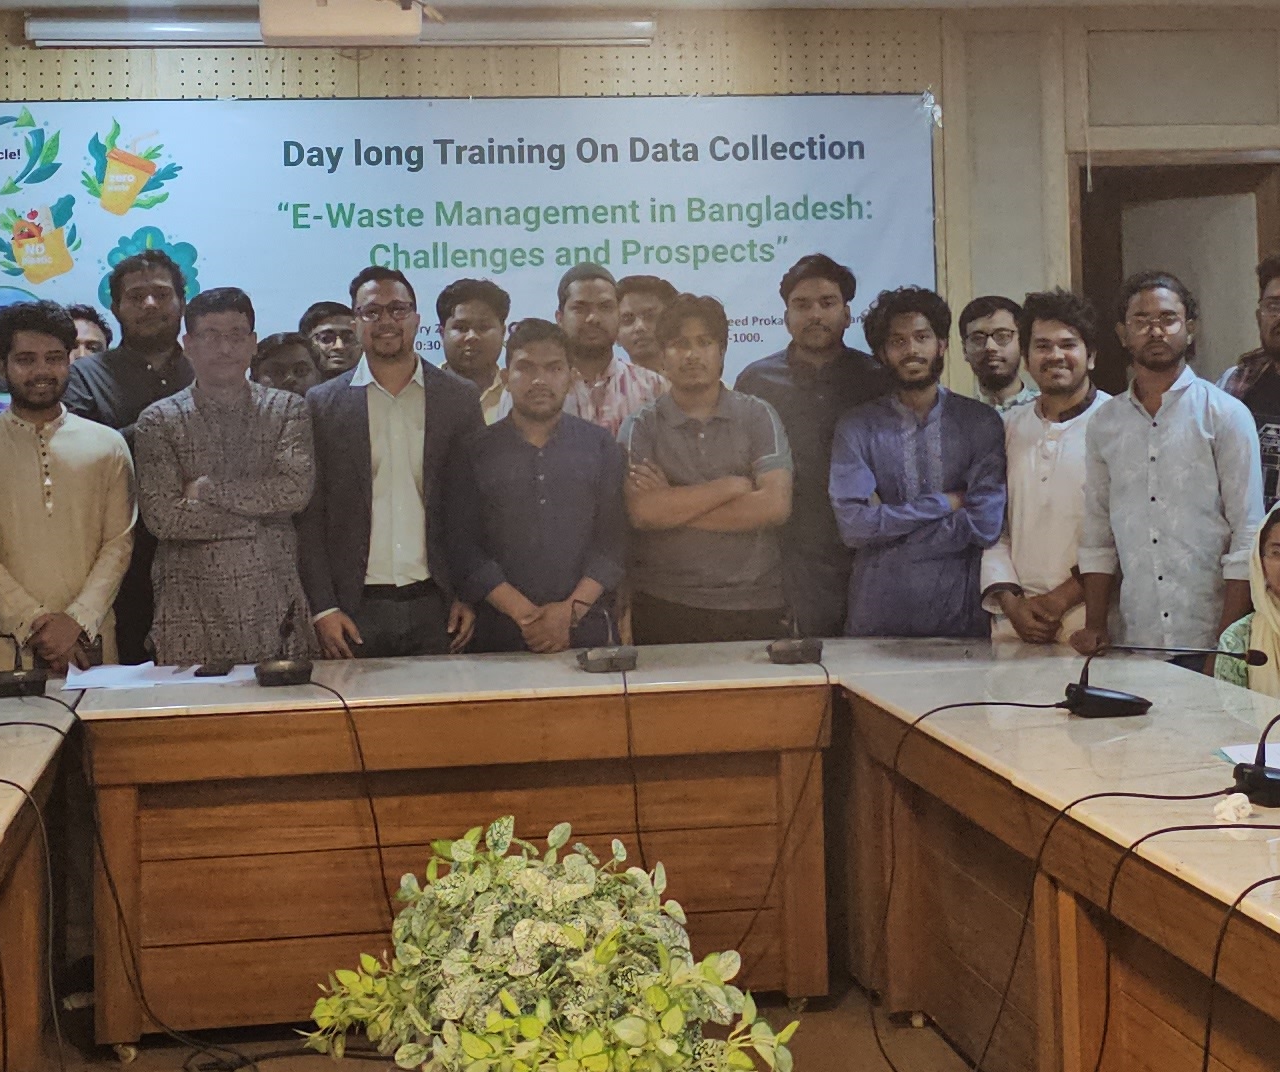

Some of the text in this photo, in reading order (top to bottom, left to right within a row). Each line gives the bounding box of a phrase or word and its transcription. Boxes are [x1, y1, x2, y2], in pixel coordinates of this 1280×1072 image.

[283, 134, 865, 174] Day long Training On Data Collection
[277, 194, 873, 232] “E-Waste Management in Bangladesh:
[369, 235, 788, 274] Challenges and Prospects”
[751, 316, 784, 326] Proka
[415, 340, 440, 351] 0:30
[728, 333, 764, 343] -1000.
